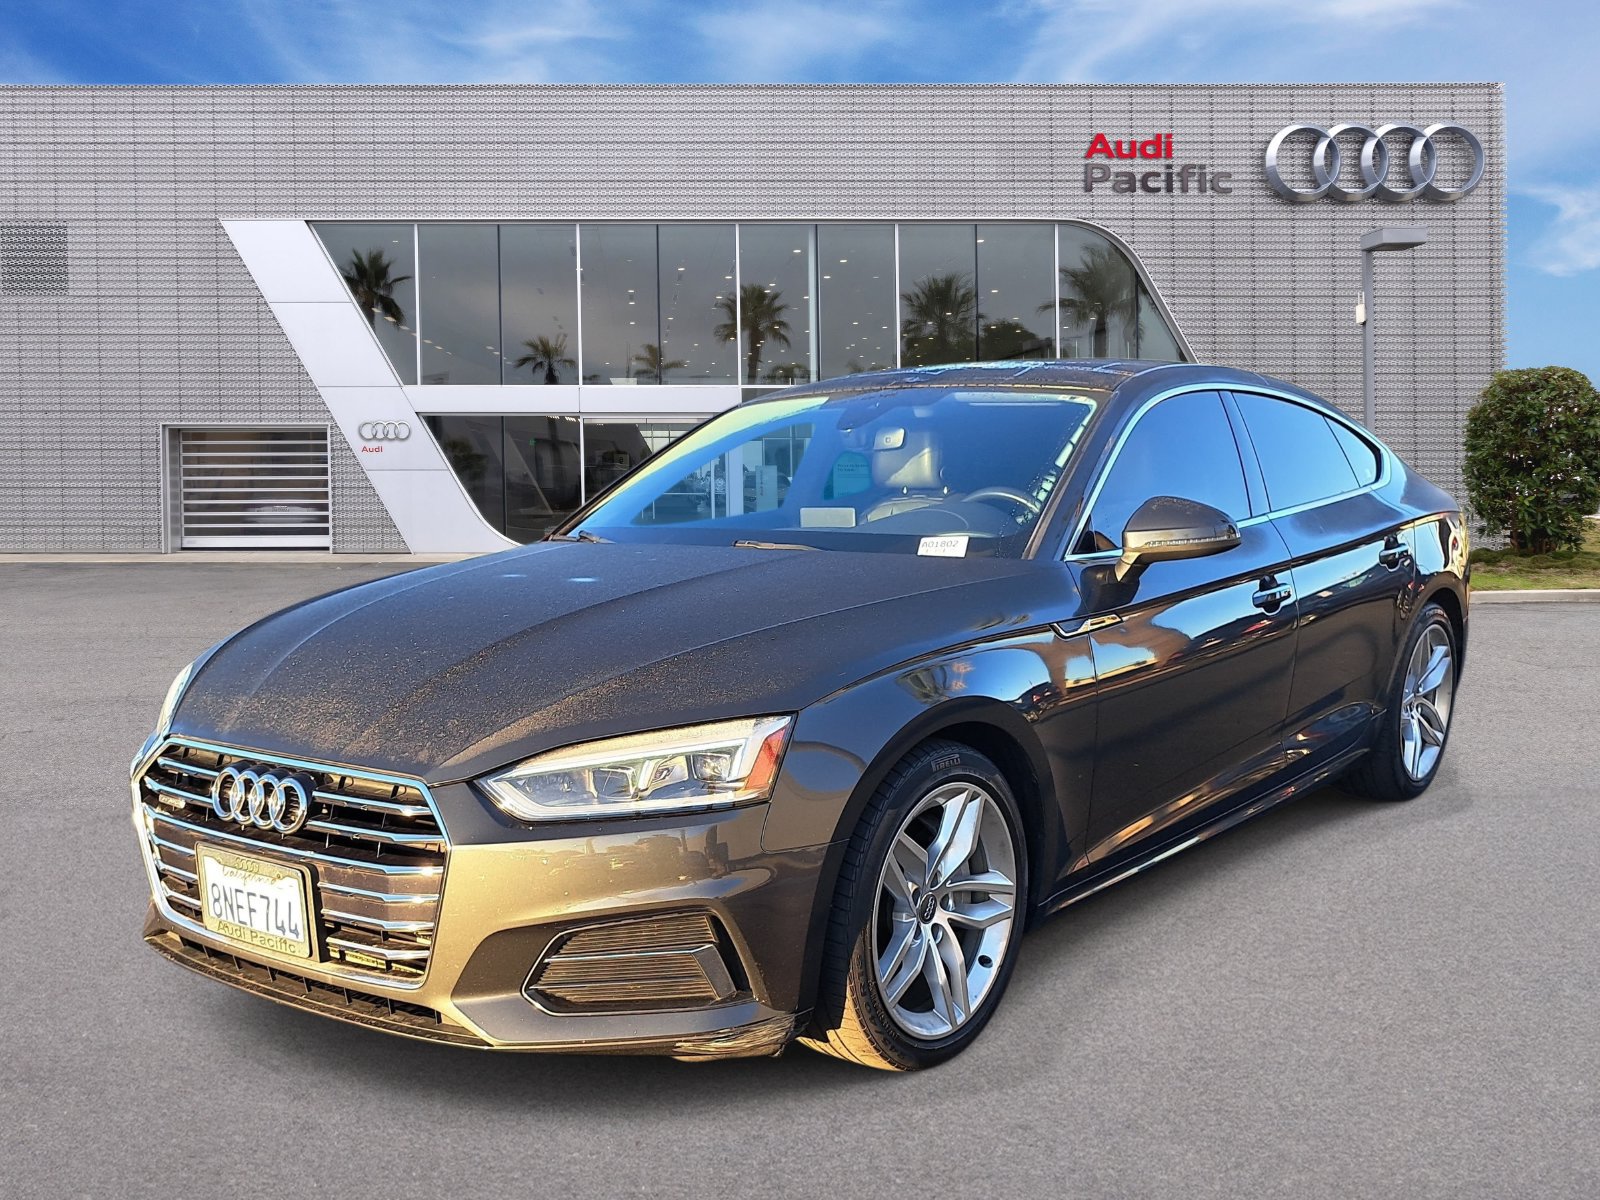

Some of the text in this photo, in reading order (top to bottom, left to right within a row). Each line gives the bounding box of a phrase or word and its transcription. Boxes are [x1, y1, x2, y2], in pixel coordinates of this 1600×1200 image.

[1085, 133, 1173, 159] Audi
[1084, 163, 1233, 193] Pacific
[931, 754, 961, 772] PIRELLI
[211, 883, 300, 939] 8NEF744
[218, 921, 297, 953] Audi Pacific
